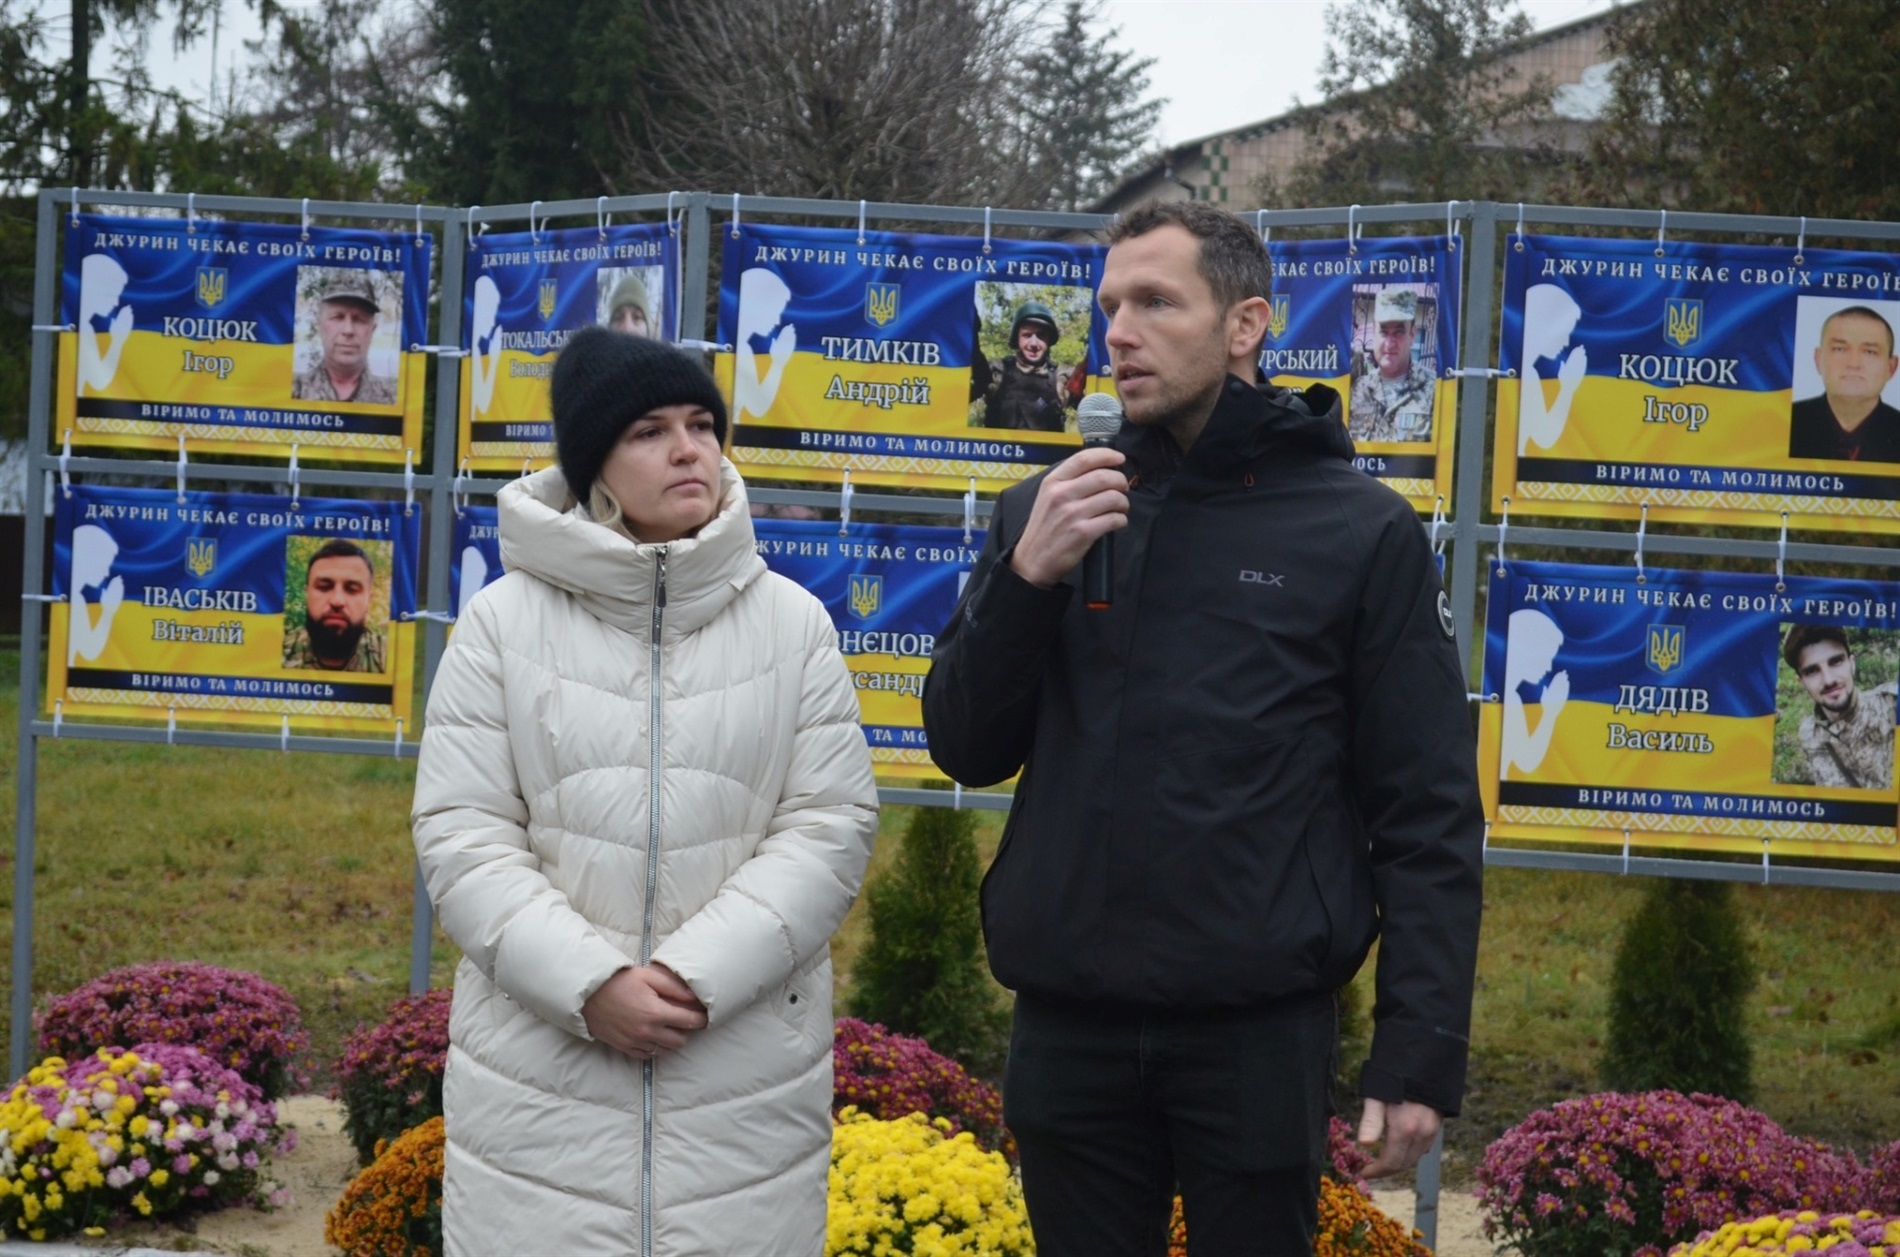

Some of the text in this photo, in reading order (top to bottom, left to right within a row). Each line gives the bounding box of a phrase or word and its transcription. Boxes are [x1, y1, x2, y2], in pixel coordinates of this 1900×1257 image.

[94, 232, 401, 263] ДЖУРИН ЧЕКАЄ СВОЇХ ГЕРОЇВ!
[481, 240, 662, 269] ДЖУРИН ЧЕКАЄ СВОЇХ ГЕРОЇВ!
[754, 245, 1091, 279] ДЖУРИН ЧЕКАЄ СВОЇХ ГЕРОЇВ!
[1271, 255, 1435, 277] ЕКАЄ СВОЇХ ГЕРОЇВ!
[1541, 258, 1643, 278] ДЖУРИН
[1654, 263, 1729, 282] ЧЕКАЄ
[1740, 266, 1811, 287] СВОЇХ
[161, 316, 257, 343] КОЦЮК
[502, 330, 573, 348] ТОКАЛЬСЬК
[184, 351, 234, 379] Ігор
[820, 336, 940, 366] ТИМКІВ
[1618, 353, 1739, 388] КОЦЮК
[826, 376, 929, 409] Андрій
[139, 404, 344, 429] ВІРИМО ТА МОЛИМОСЬ
[1645, 396, 1708, 431] Ігор
[505, 424, 547, 437] ВІРИМО
[800, 431, 1025, 459] ВІРИМО ТА МОЛИМОСЬ
[1596, 464, 1844, 492] ВІРИМО ТА МОЛИМОСЬ
[85, 503, 390, 532] ДЖУРИН ЧЕКАЄ СВОЇХ ГЕРОЇВ!
[468, 525, 498, 539] ДЖУР
[755, 540, 979, 564] ЖУРИН ЧЕКАЄ СВОЇХ
[1238, 569, 1286, 587] DLX
[143, 586, 259, 614] ІВАСЬКІВ
[1524, 583, 1896, 619] ДЖУРИН ЧЕКАЄ СВОЇХ ГЕРОЇВ!
[153, 619, 243, 644] Віталій
[837, 630, 935, 659] НЄЦОВ
[129, 674, 334, 699] ВІРИМО ТА МОЛИМОСЬ
[1612, 684, 1709, 716] ДЯДІВ
[872, 728, 893, 742] ТА
[1608, 724, 1713, 753] Василь
[1578, 788, 1825, 818] ВІРИМО ТА МОЛИМОСЬ
